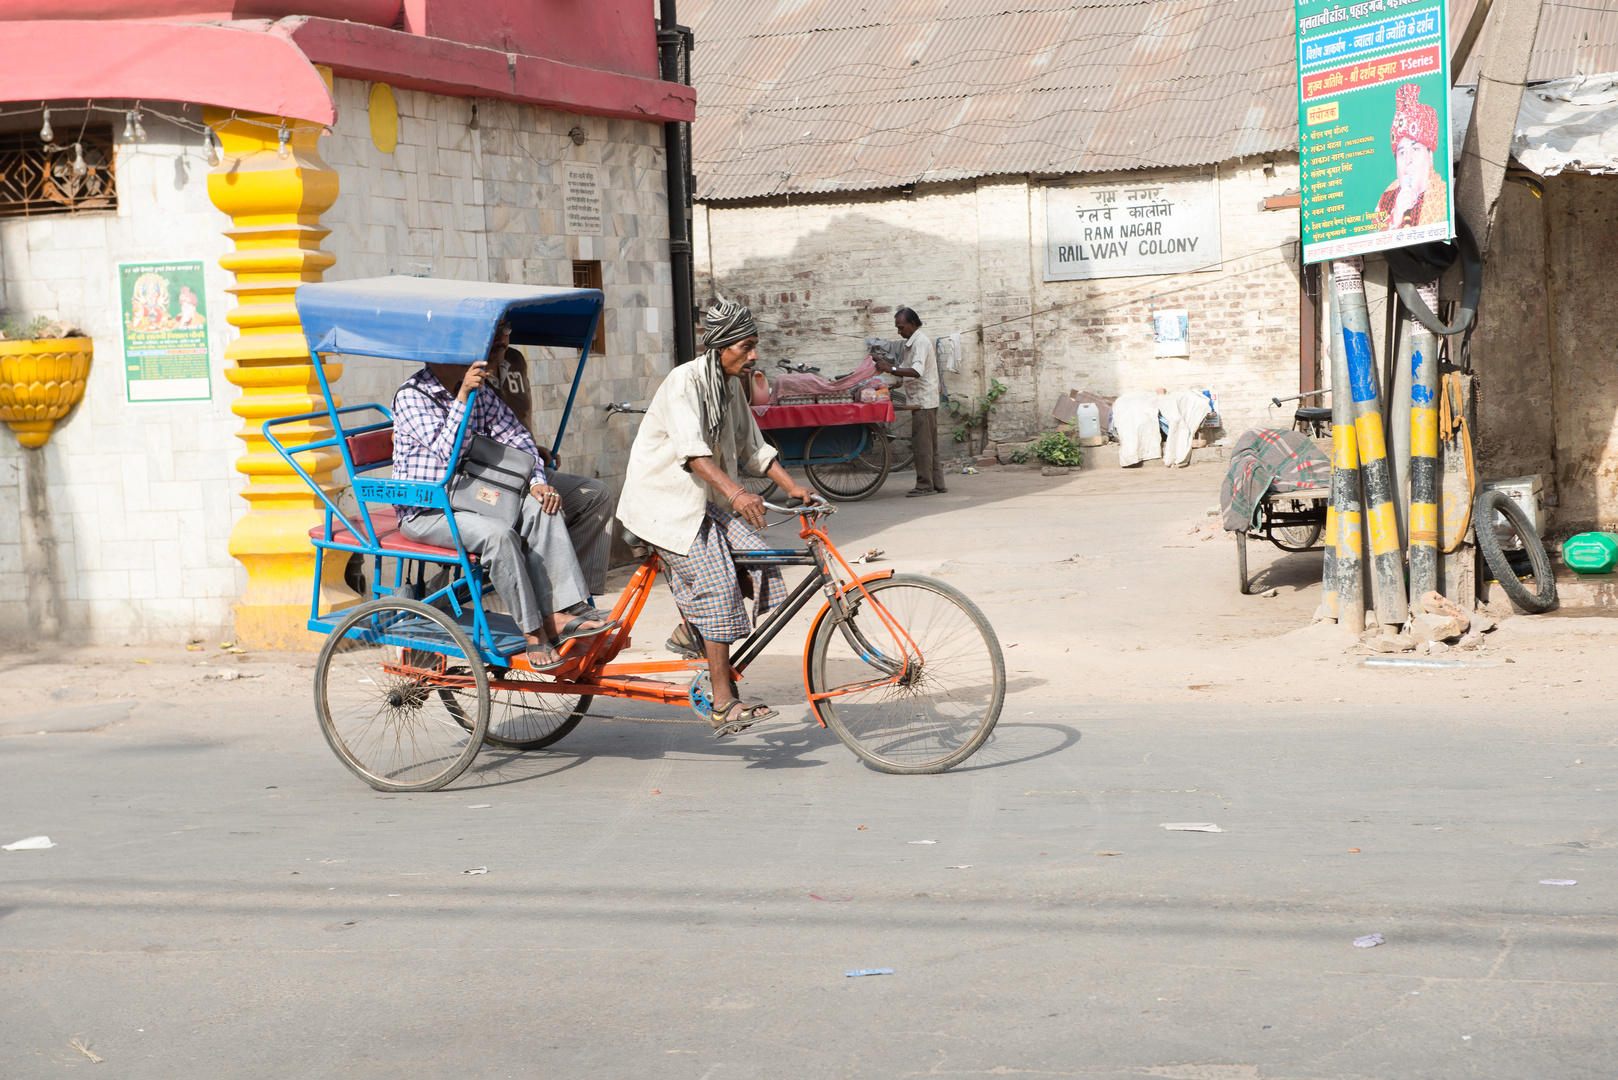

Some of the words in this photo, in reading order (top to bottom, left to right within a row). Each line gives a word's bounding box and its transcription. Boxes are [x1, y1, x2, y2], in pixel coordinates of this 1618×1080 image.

[1400, 55, 1434, 71] T-Series
[1124, 188, 1164, 201] नगर
[1076, 204, 1118, 223] रेलवे
[1084, 226, 1114, 241] RAM
[1120, 222, 1162, 238] NAGAR
[1058, 241, 1128, 262] RAILWAY
[1138, 237, 1199, 256] COLONY
[507, 371, 525, 393] 67
